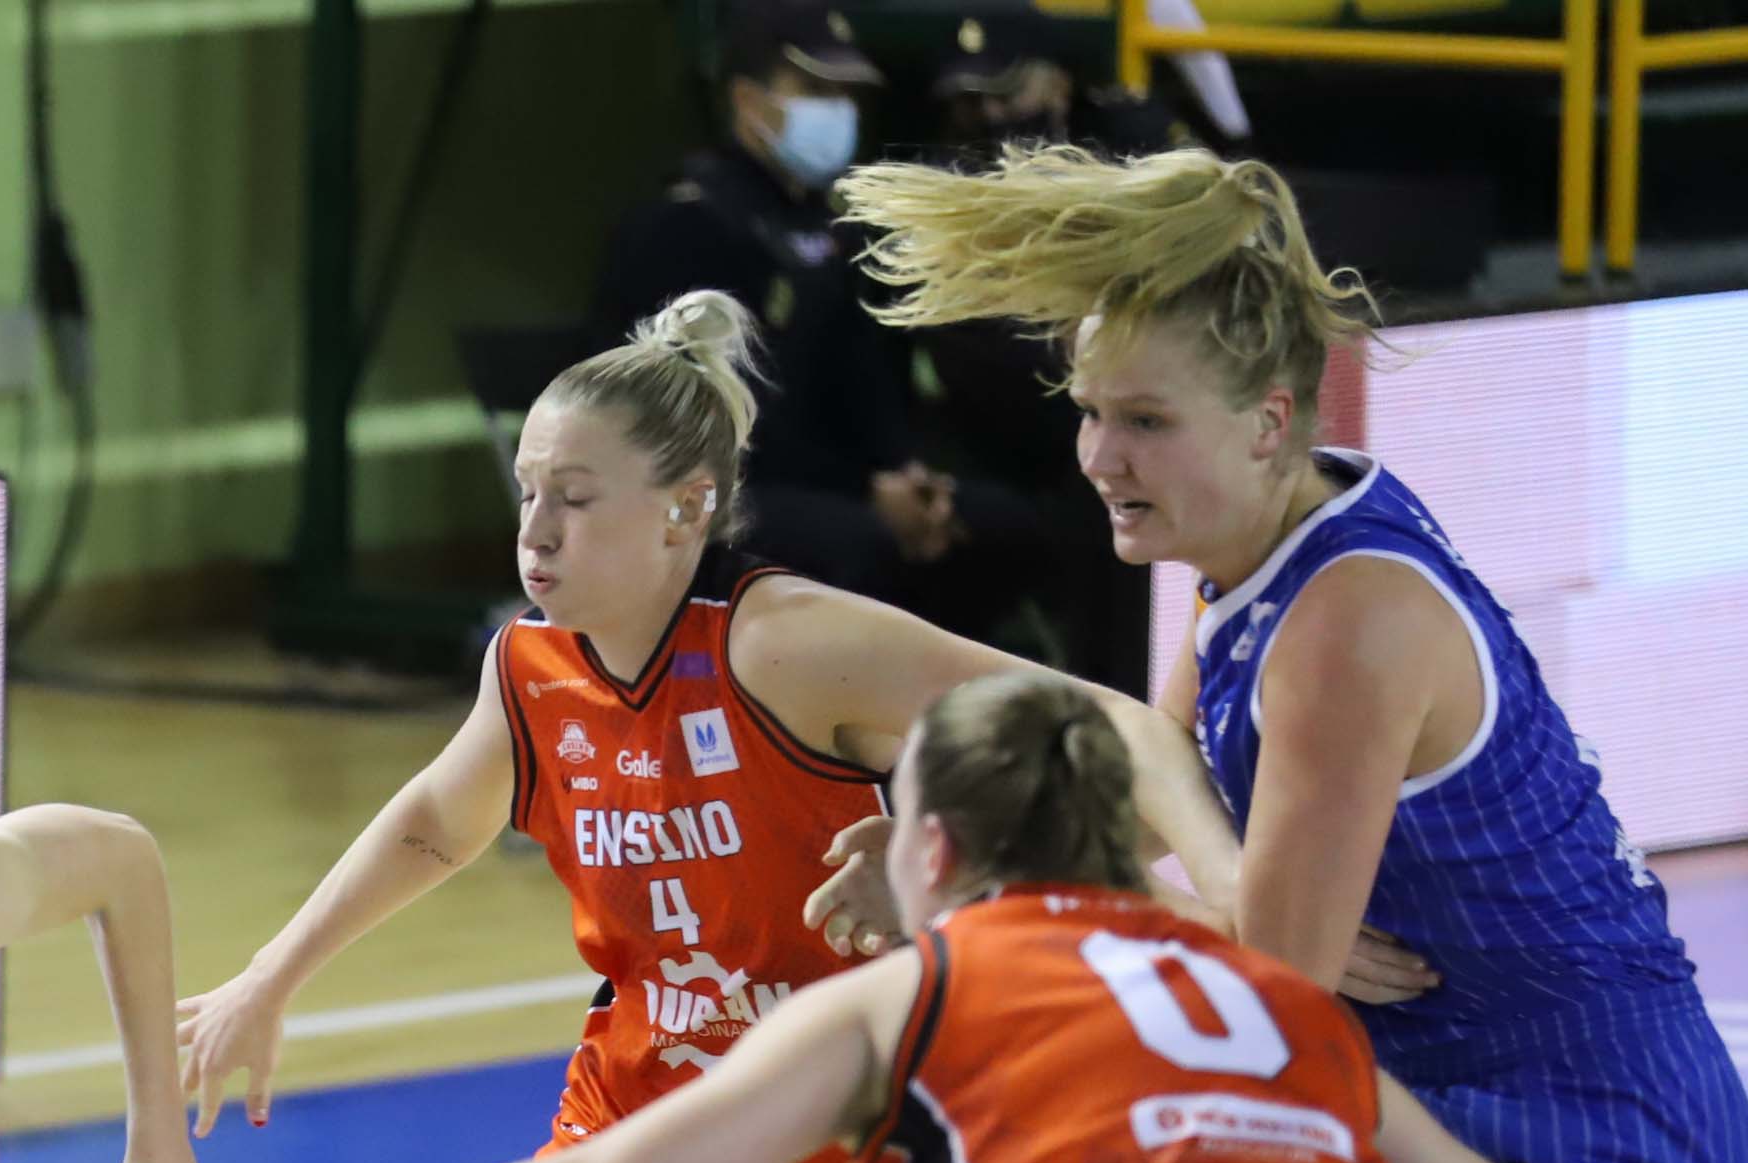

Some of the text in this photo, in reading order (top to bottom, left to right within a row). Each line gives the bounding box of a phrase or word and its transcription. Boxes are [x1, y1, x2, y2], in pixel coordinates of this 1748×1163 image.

[575, 800, 742, 867] ENSINO
[649, 878, 700, 945] 4
[1079, 930, 1291, 1079] 0
